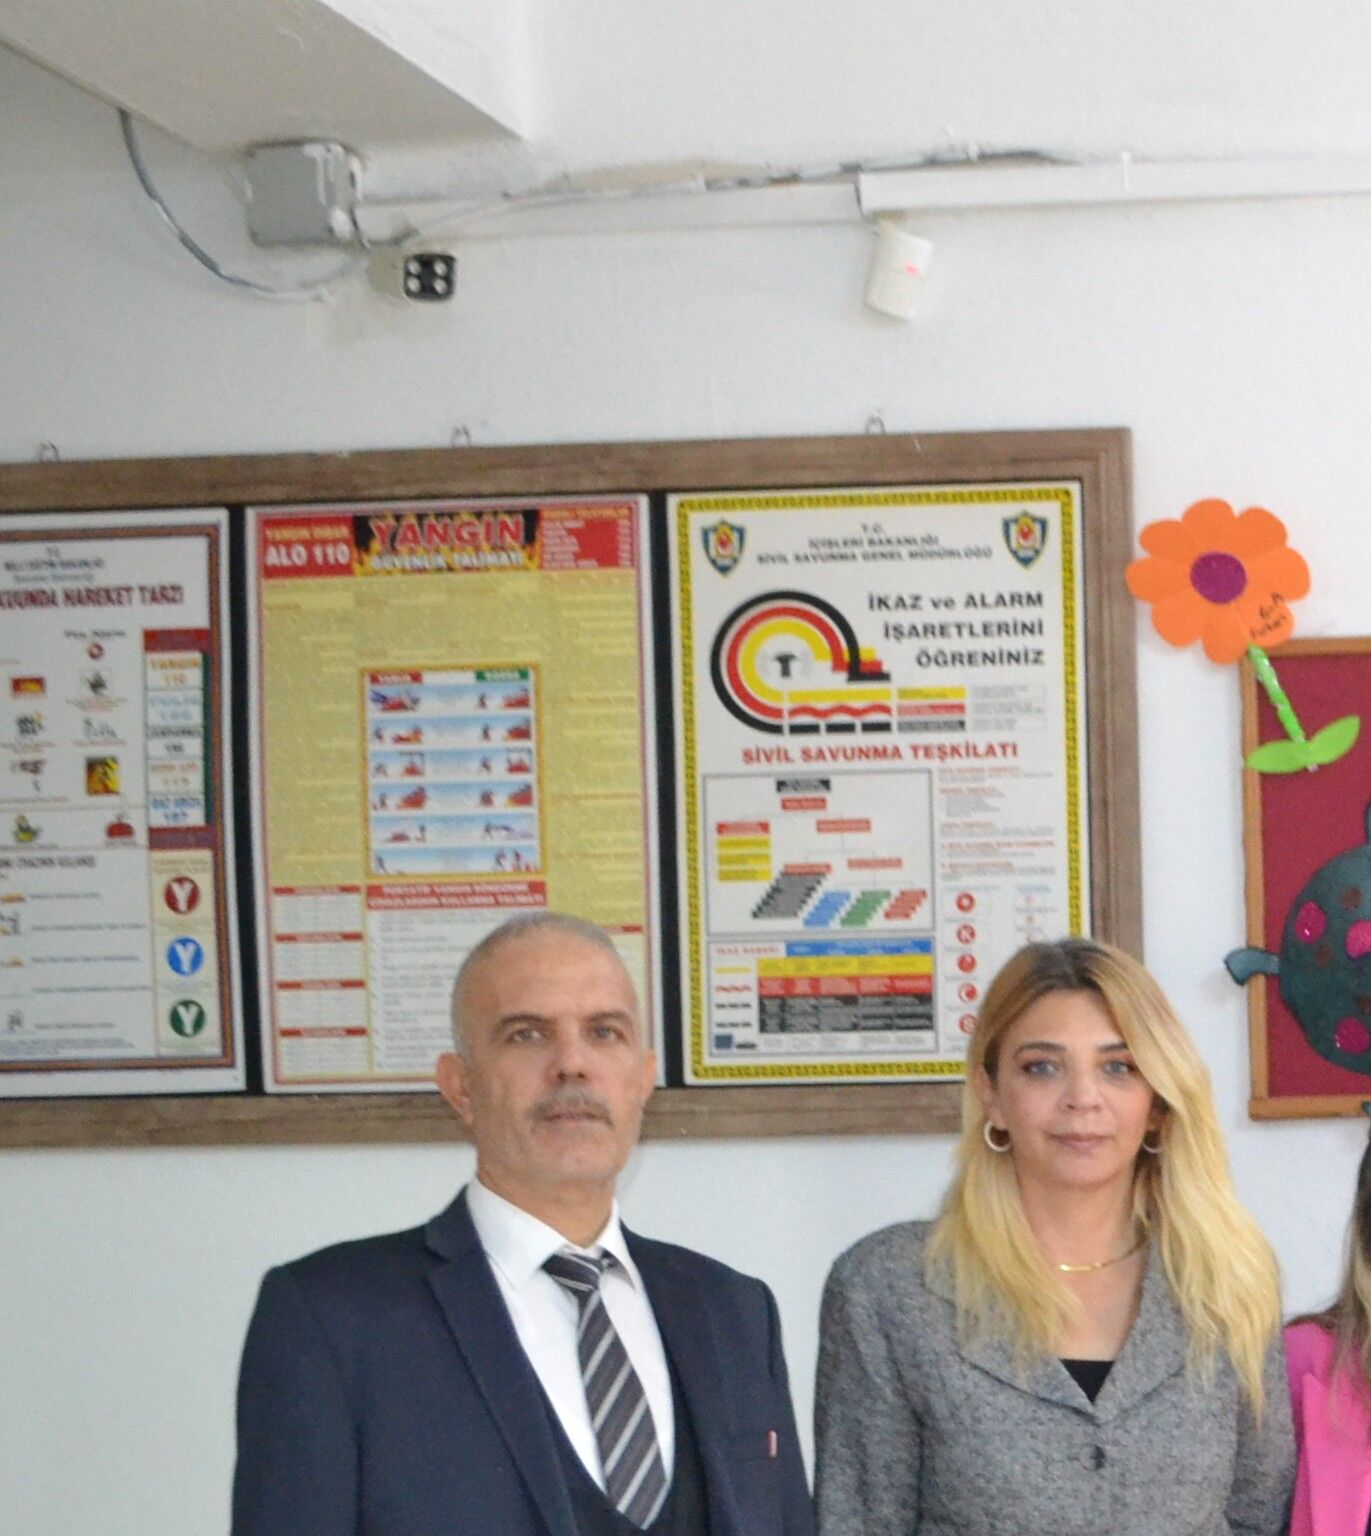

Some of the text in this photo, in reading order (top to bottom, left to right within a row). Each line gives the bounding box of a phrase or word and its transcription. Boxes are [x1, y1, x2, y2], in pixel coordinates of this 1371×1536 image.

[369, 513, 526, 551] YANGIN
[265, 542, 351, 566] ALO 110
[868, 591, 1044, 612] İKAZ ve ALARM
[883, 619, 1044, 642] İŞARETLERİNİ
[915, 647, 1046, 668] ÖĞRENİNİZ
[742, 742, 1019, 764] SİVİL SAVUNMA TEŞKİLATI
